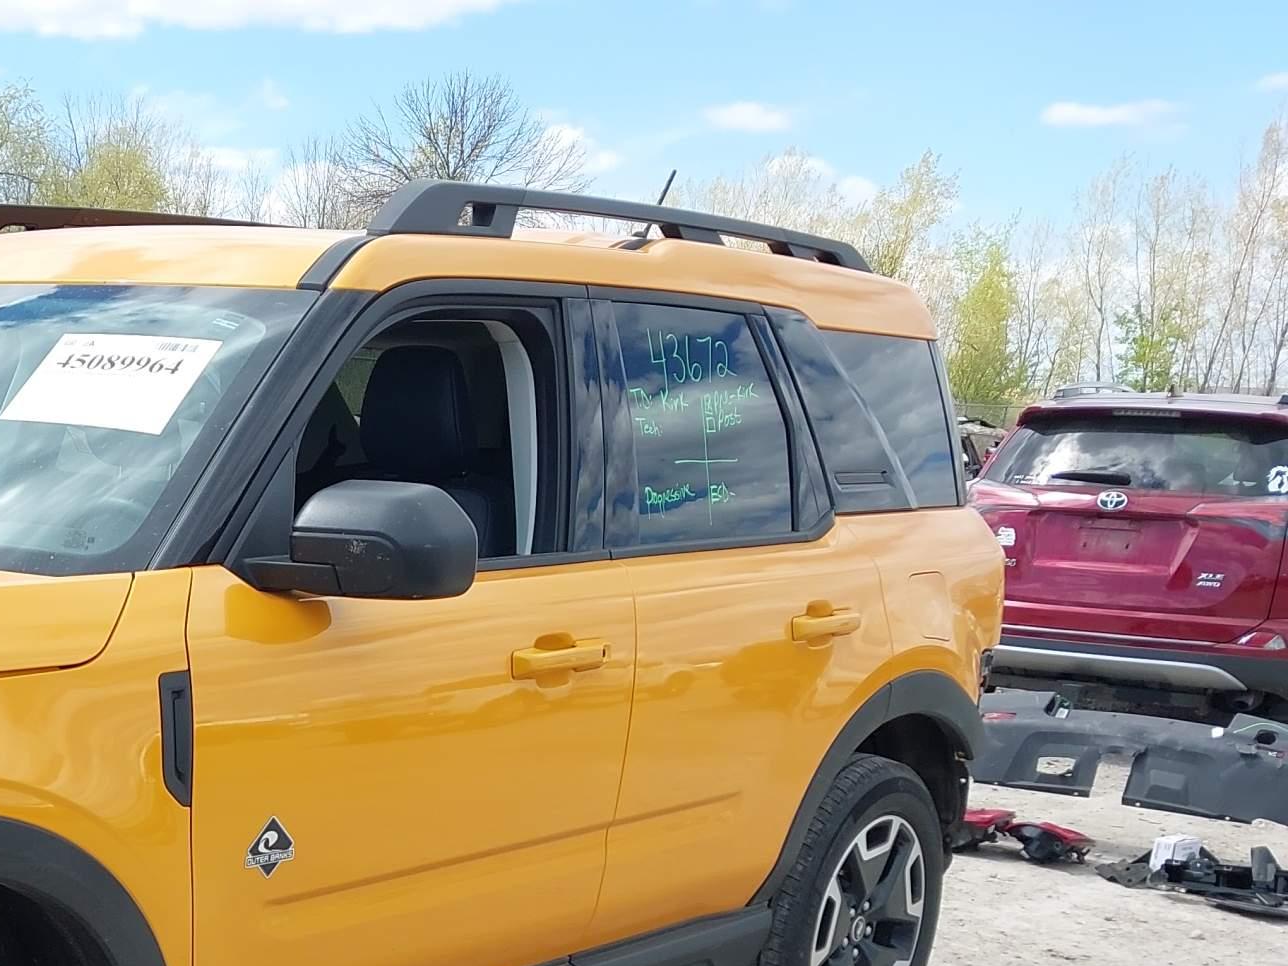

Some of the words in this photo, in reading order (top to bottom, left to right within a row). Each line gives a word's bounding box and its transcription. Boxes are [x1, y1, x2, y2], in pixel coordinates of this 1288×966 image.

[56, 353, 184, 375] 45089964
[647, 328, 738, 391] 43672
[1197, 572, 1225, 581] XLE
[247, 854, 269, 866] OUTER
[269, 850, 293, 862] BANKS
